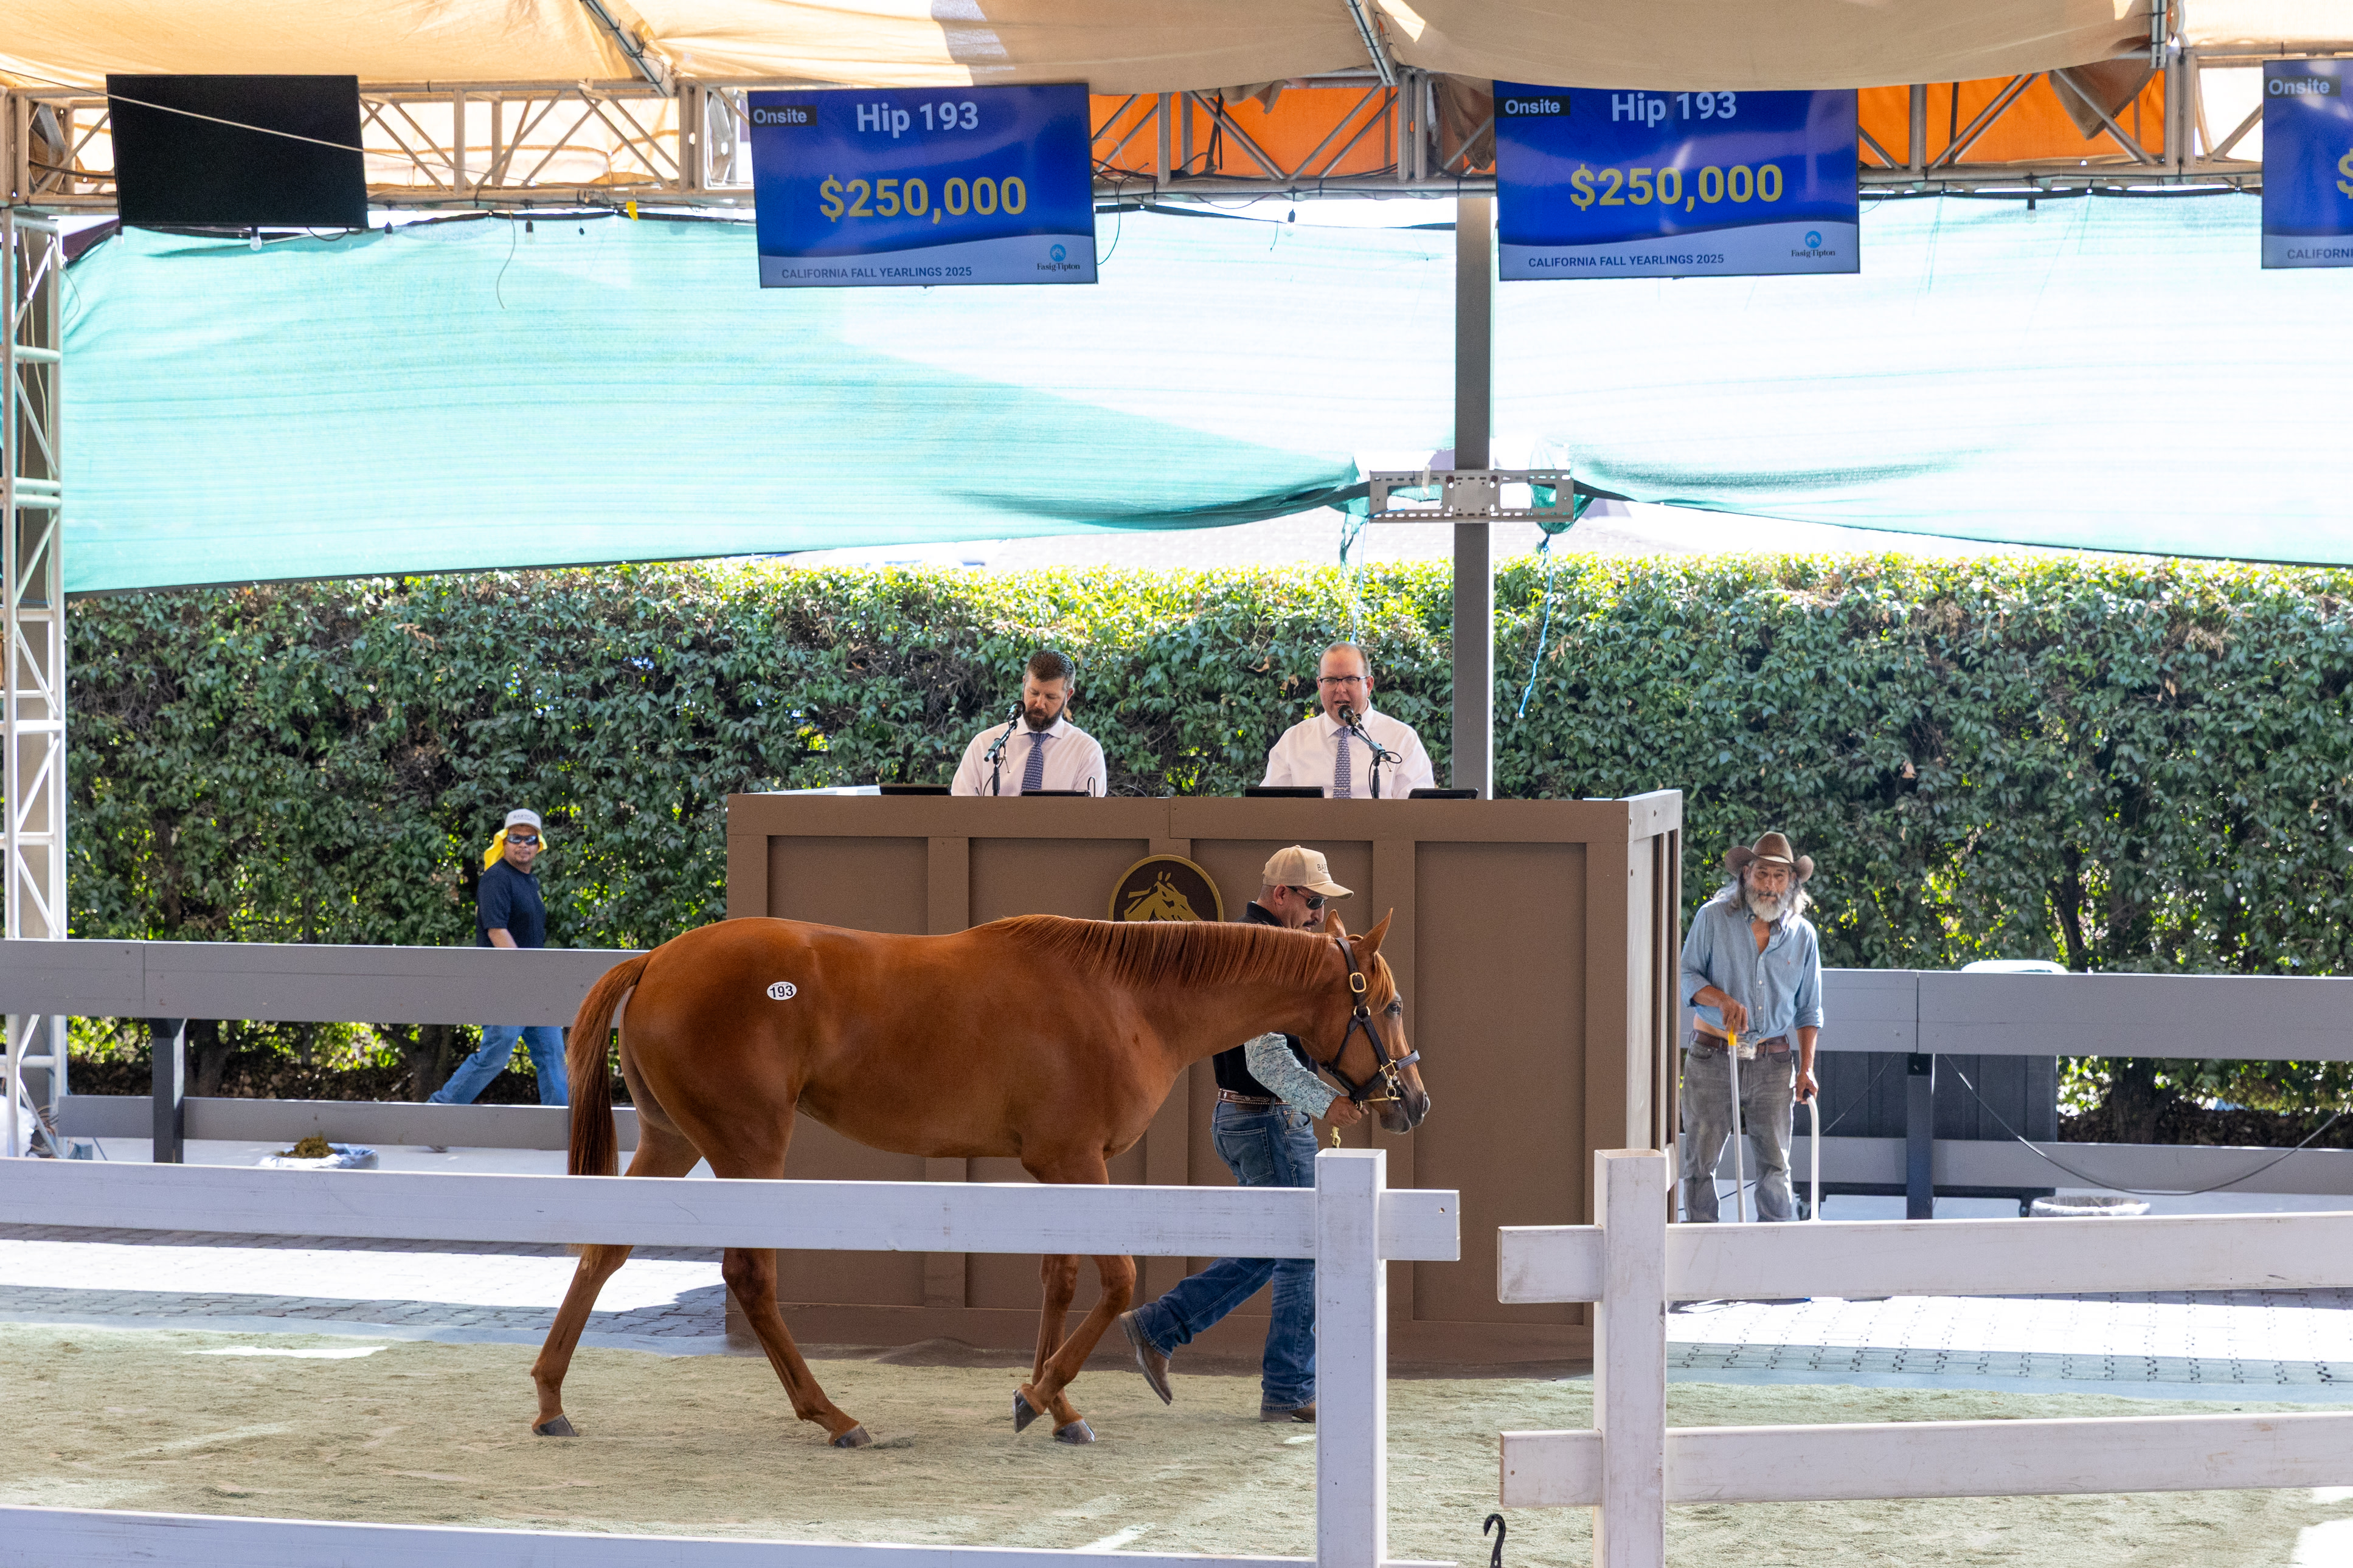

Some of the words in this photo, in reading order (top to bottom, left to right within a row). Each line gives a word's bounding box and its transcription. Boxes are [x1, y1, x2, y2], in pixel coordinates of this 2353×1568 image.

[2268, 78, 2330, 95] Onsite
[1505, 99, 1560, 114] Onsite
[1612, 92, 1666, 128] Hip
[1676, 91, 1736, 119] 193
[754, 108, 807, 124] Onsite
[856, 103, 910, 139] Hip
[919, 102, 979, 131] 193
[1570, 164, 1783, 213] $250,000
[819, 174, 1027, 224] $250,000
[1528, 257, 1596, 267] CALIFORNIA
[1600, 257, 1626, 266] FALL
[1629, 255, 1693, 266] YEARLINGS
[1696, 254, 1724, 264] 2025
[782, 269, 848, 278] CALIFORNIA
[851, 269, 877, 278] FALL
[879, 268, 942, 277] YEARLINGS
[945, 267, 972, 276] 2025
[770, 985, 793, 998] 193
